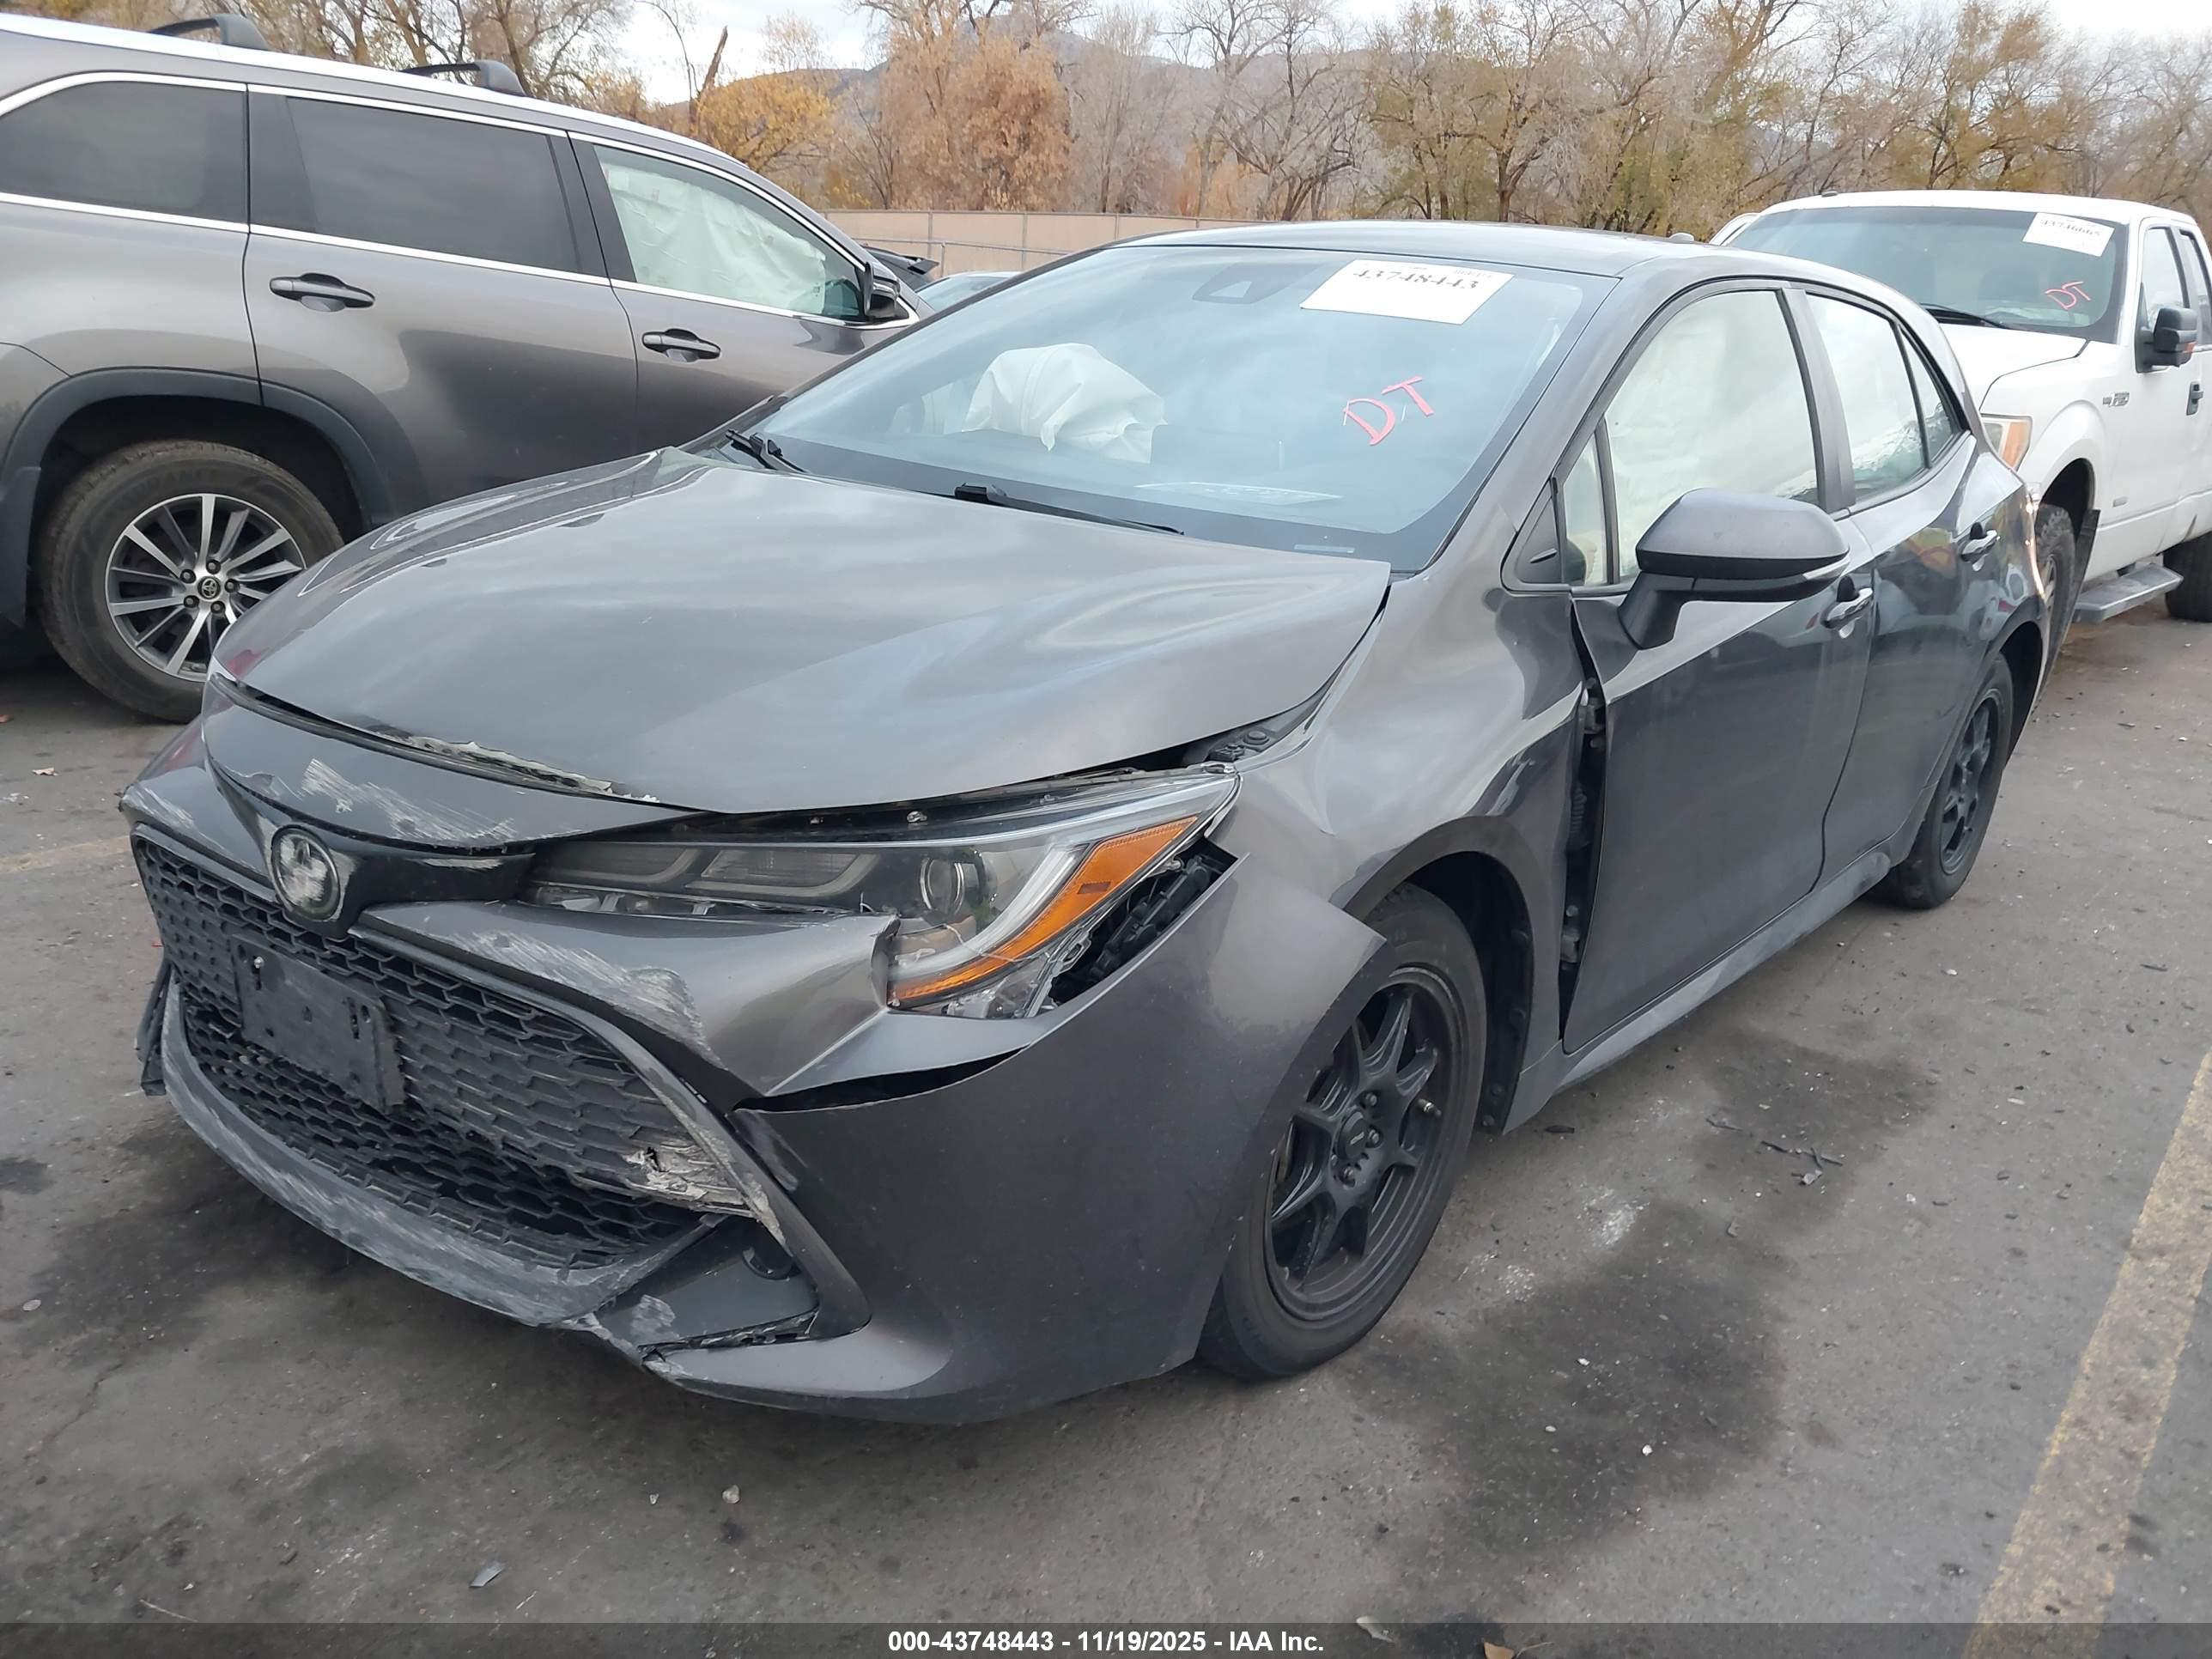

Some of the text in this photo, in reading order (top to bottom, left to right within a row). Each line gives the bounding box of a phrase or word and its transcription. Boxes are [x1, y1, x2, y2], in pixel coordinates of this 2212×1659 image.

[1353, 270, 1479, 289] 43748443
[2045, 281, 2092, 310] DT
[1342, 376, 1434, 446] DT
